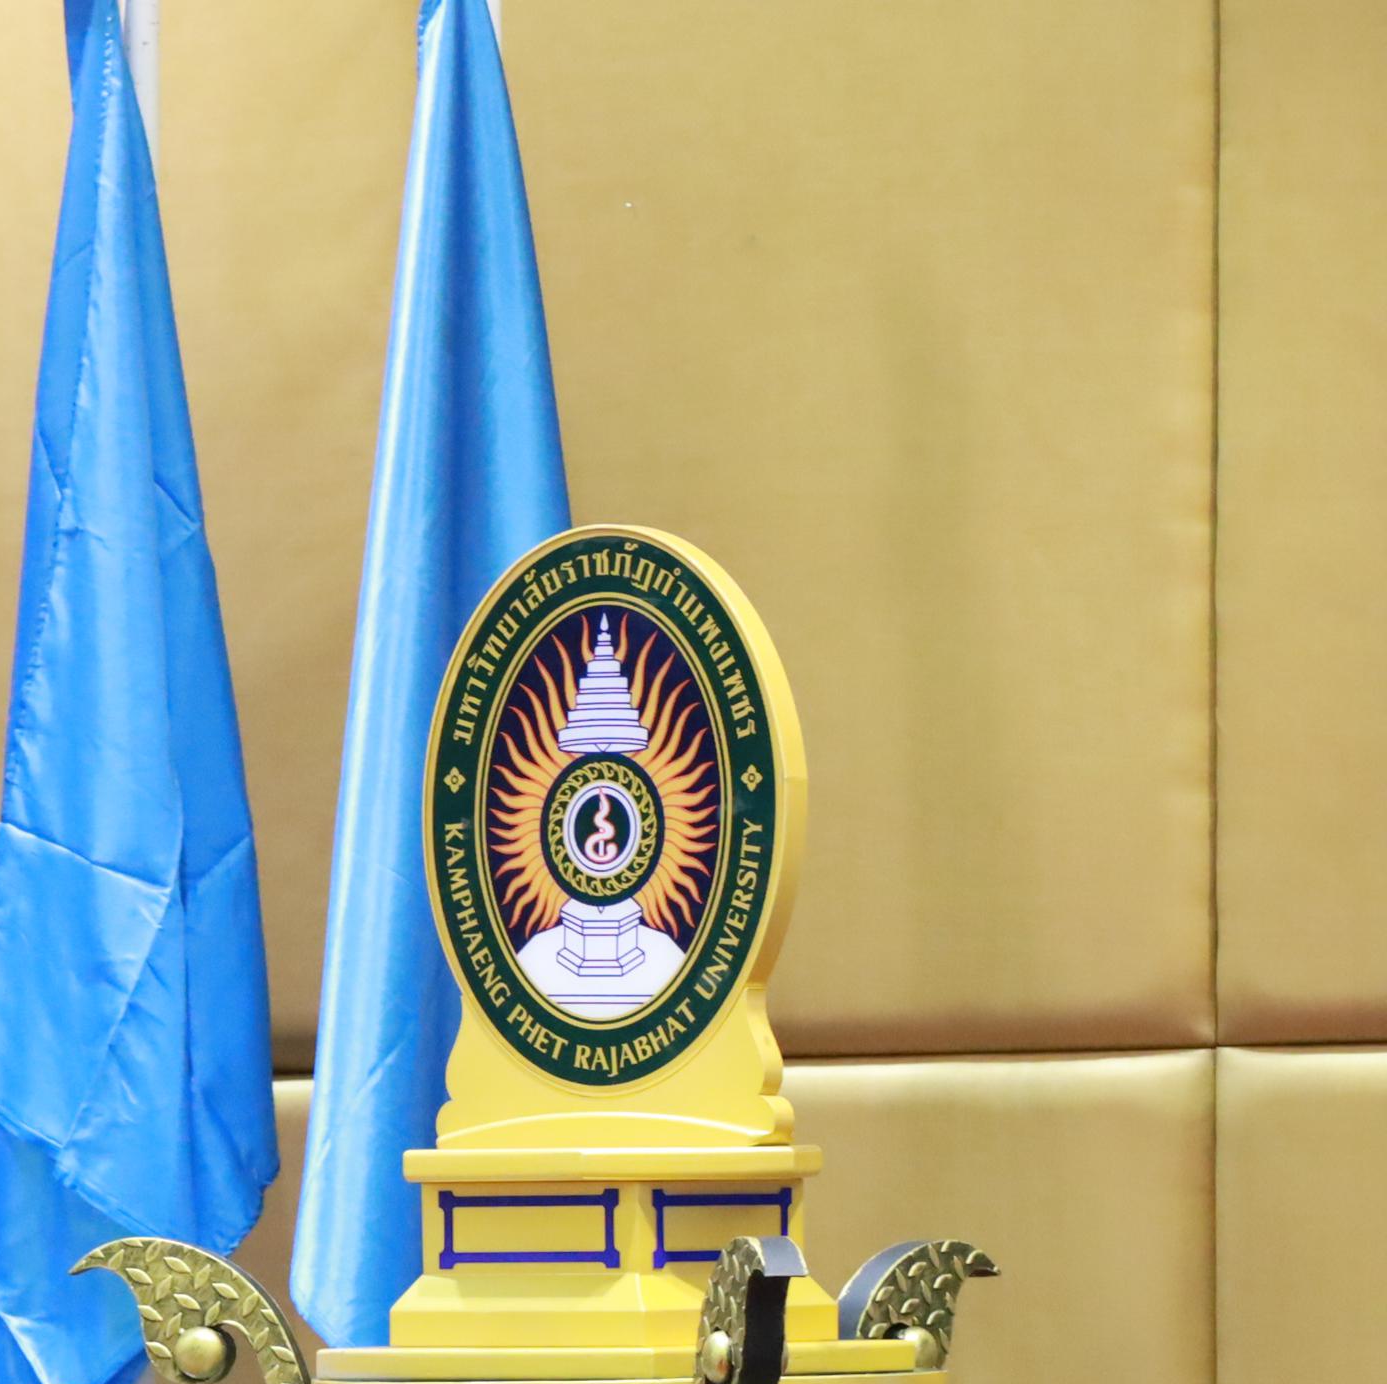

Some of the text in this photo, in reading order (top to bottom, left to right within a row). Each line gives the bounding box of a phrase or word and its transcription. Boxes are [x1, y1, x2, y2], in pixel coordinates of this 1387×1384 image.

[453, 541, 757, 745] มหาวิทยาลัยราชภัฏกำแพงเพชร
[444, 818, 763, 1077] KAMPHAENG PHET RAJABHAT UNIVERSITY
